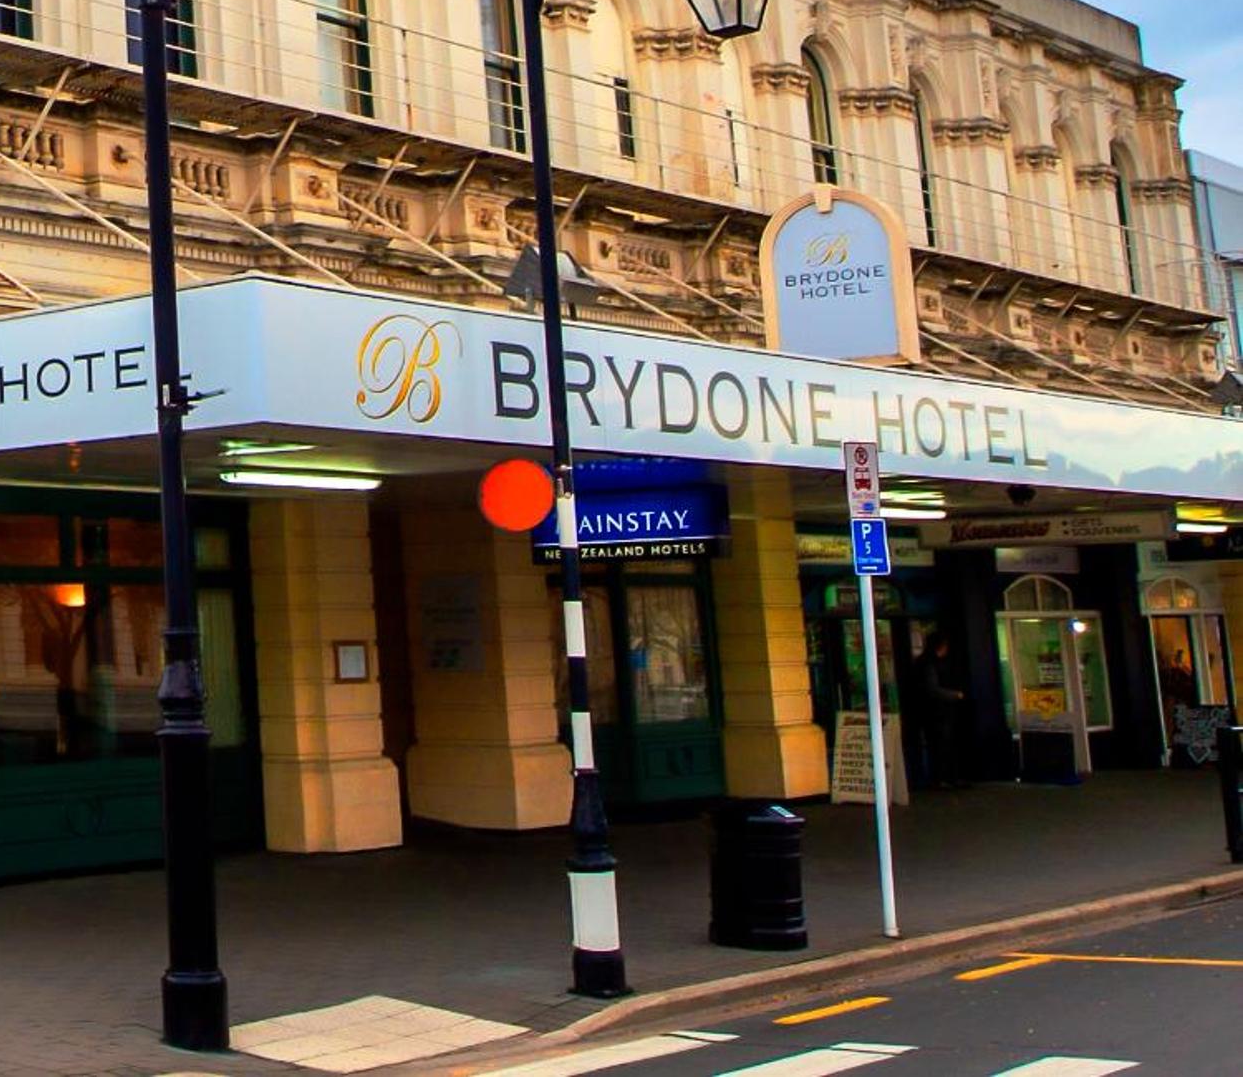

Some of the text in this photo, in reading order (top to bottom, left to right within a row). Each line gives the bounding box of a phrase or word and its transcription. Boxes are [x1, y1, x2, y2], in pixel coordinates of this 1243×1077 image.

[785, 264, 886, 288] BRYDONE
[801, 283, 871, 299] HOTEL
[356, 314, 1048, 466] B BRYDONE HOTEL
[555, 509, 691, 535] AINSTAY
[861, 523, 872, 540] P
[581, 545, 645, 559] ZEALAND
[650, 542, 706, 555] HOTELS
[865, 541, 871, 555] 5
